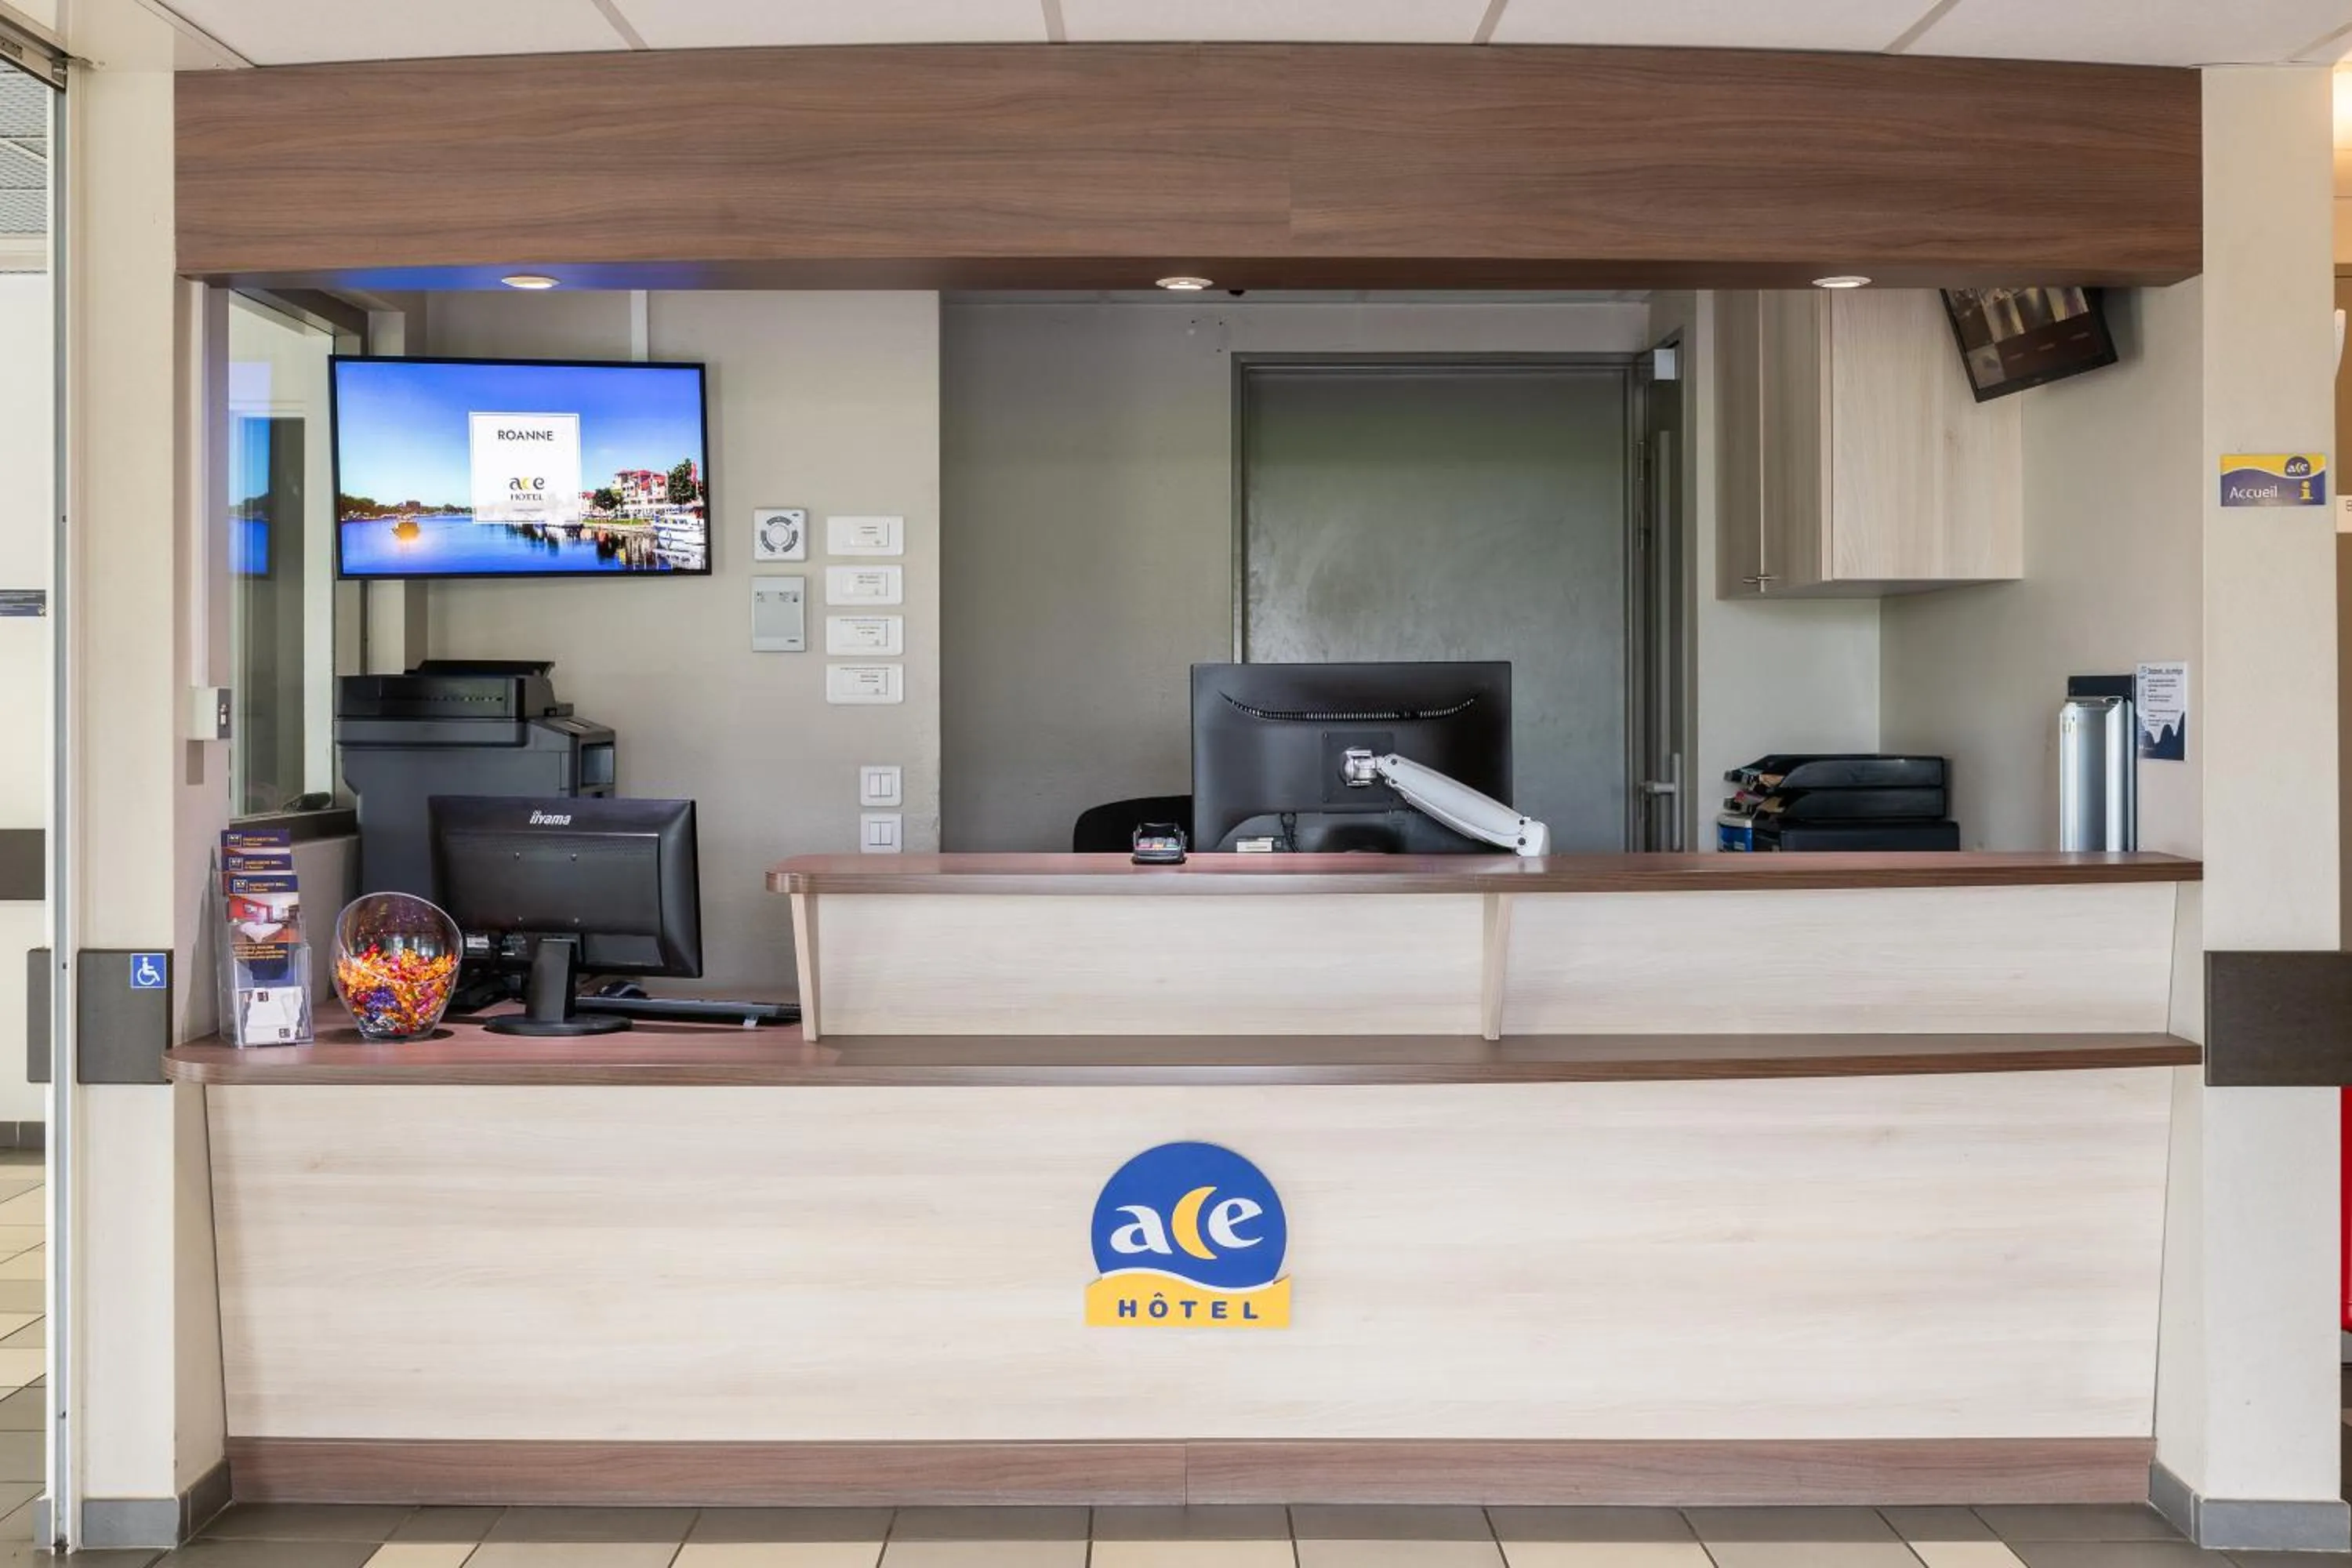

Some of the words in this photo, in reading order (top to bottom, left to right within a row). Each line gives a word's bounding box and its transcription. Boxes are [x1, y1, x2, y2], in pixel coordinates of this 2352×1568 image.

[498, 430, 554, 441] ROANNE
[510, 477, 545, 490] ace
[2229, 485, 2278, 499] Accueil
[1110, 1186, 1264, 1260] ace
[1118, 1292, 1259, 1319] HÔTEL
